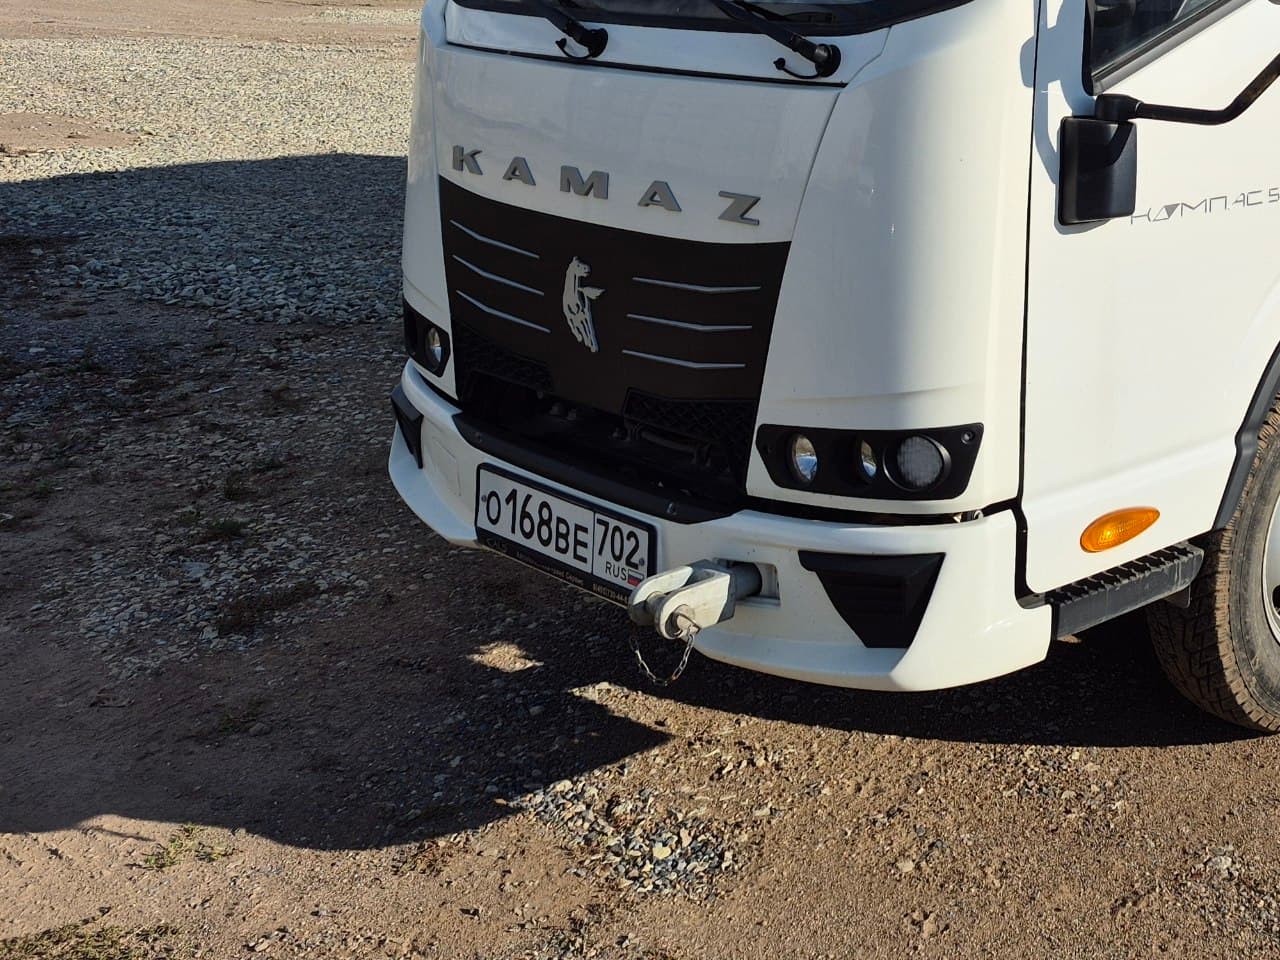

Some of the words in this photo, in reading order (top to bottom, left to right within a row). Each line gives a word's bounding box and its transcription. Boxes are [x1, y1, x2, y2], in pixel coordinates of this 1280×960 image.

[452, 144, 761, 226] KAMAZ
[596, 517, 640, 570] 702
[605, 561, 628, 581] RUS
